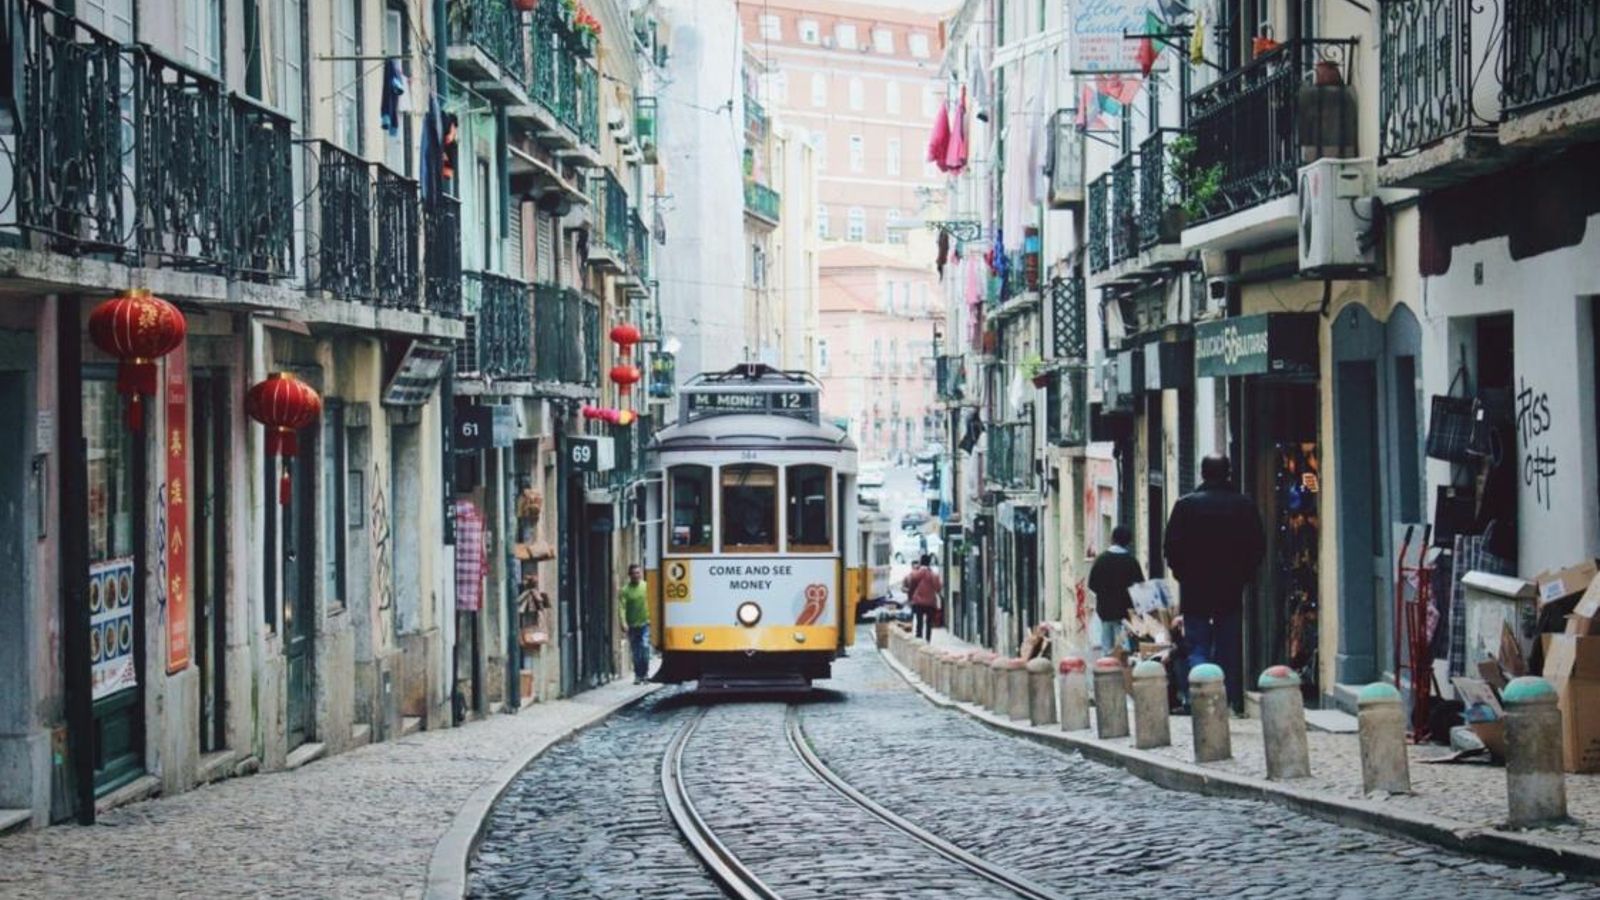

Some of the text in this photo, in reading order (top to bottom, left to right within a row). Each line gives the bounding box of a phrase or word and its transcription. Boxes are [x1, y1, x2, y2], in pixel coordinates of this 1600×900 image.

[781, 393, 801, 408] 12
[462, 422, 479, 437] 61
[572, 445, 591, 463] 69
[709, 565, 793, 576] COME AND SEE
[729, 580, 772, 591] MONEY
